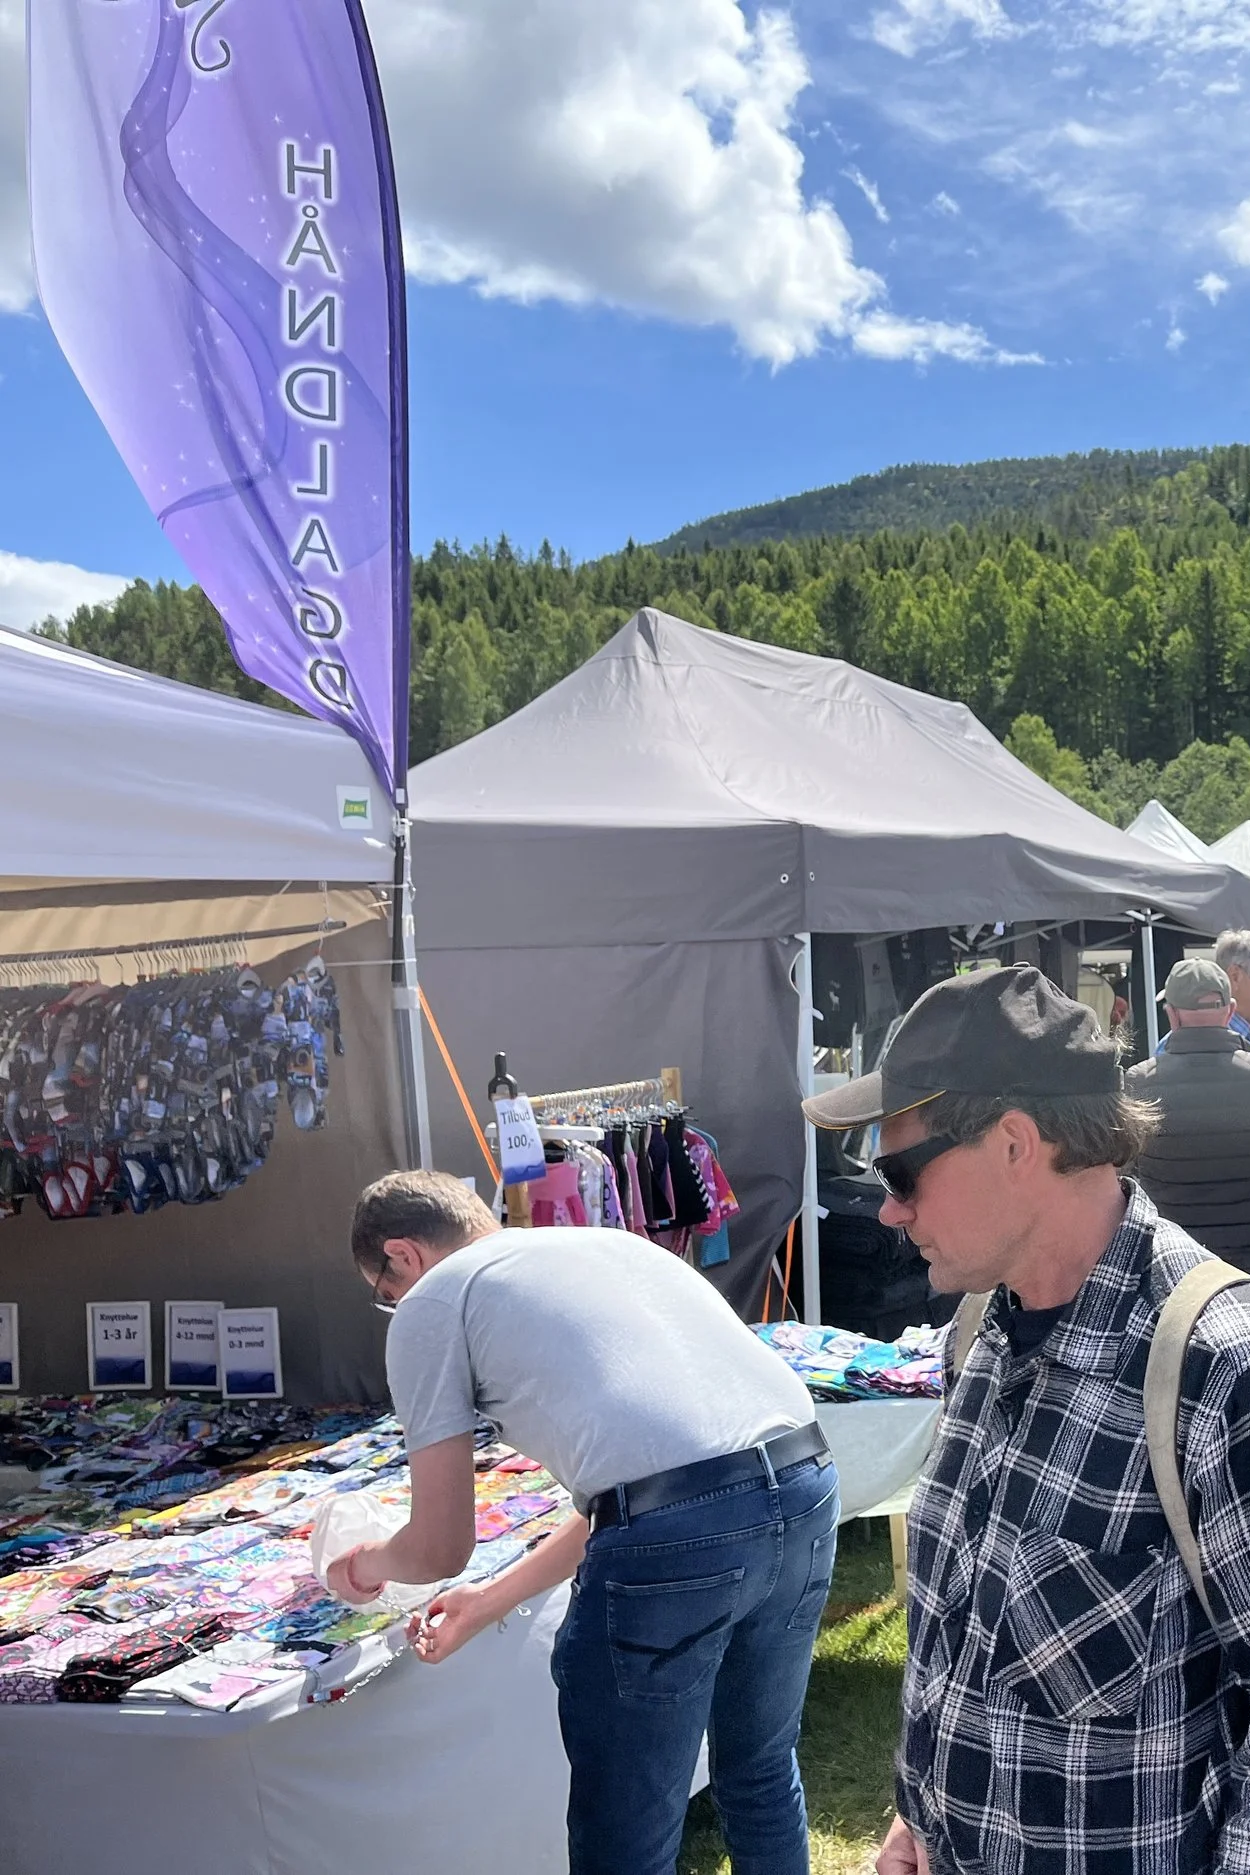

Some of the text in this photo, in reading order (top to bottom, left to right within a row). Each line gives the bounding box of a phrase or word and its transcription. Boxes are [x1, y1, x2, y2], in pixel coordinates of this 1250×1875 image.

[500, 1109, 531, 1125] Tilbud
[508, 1134, 535, 1150] 100,-
[103, 1327, 138, 1340] 1-3 år
